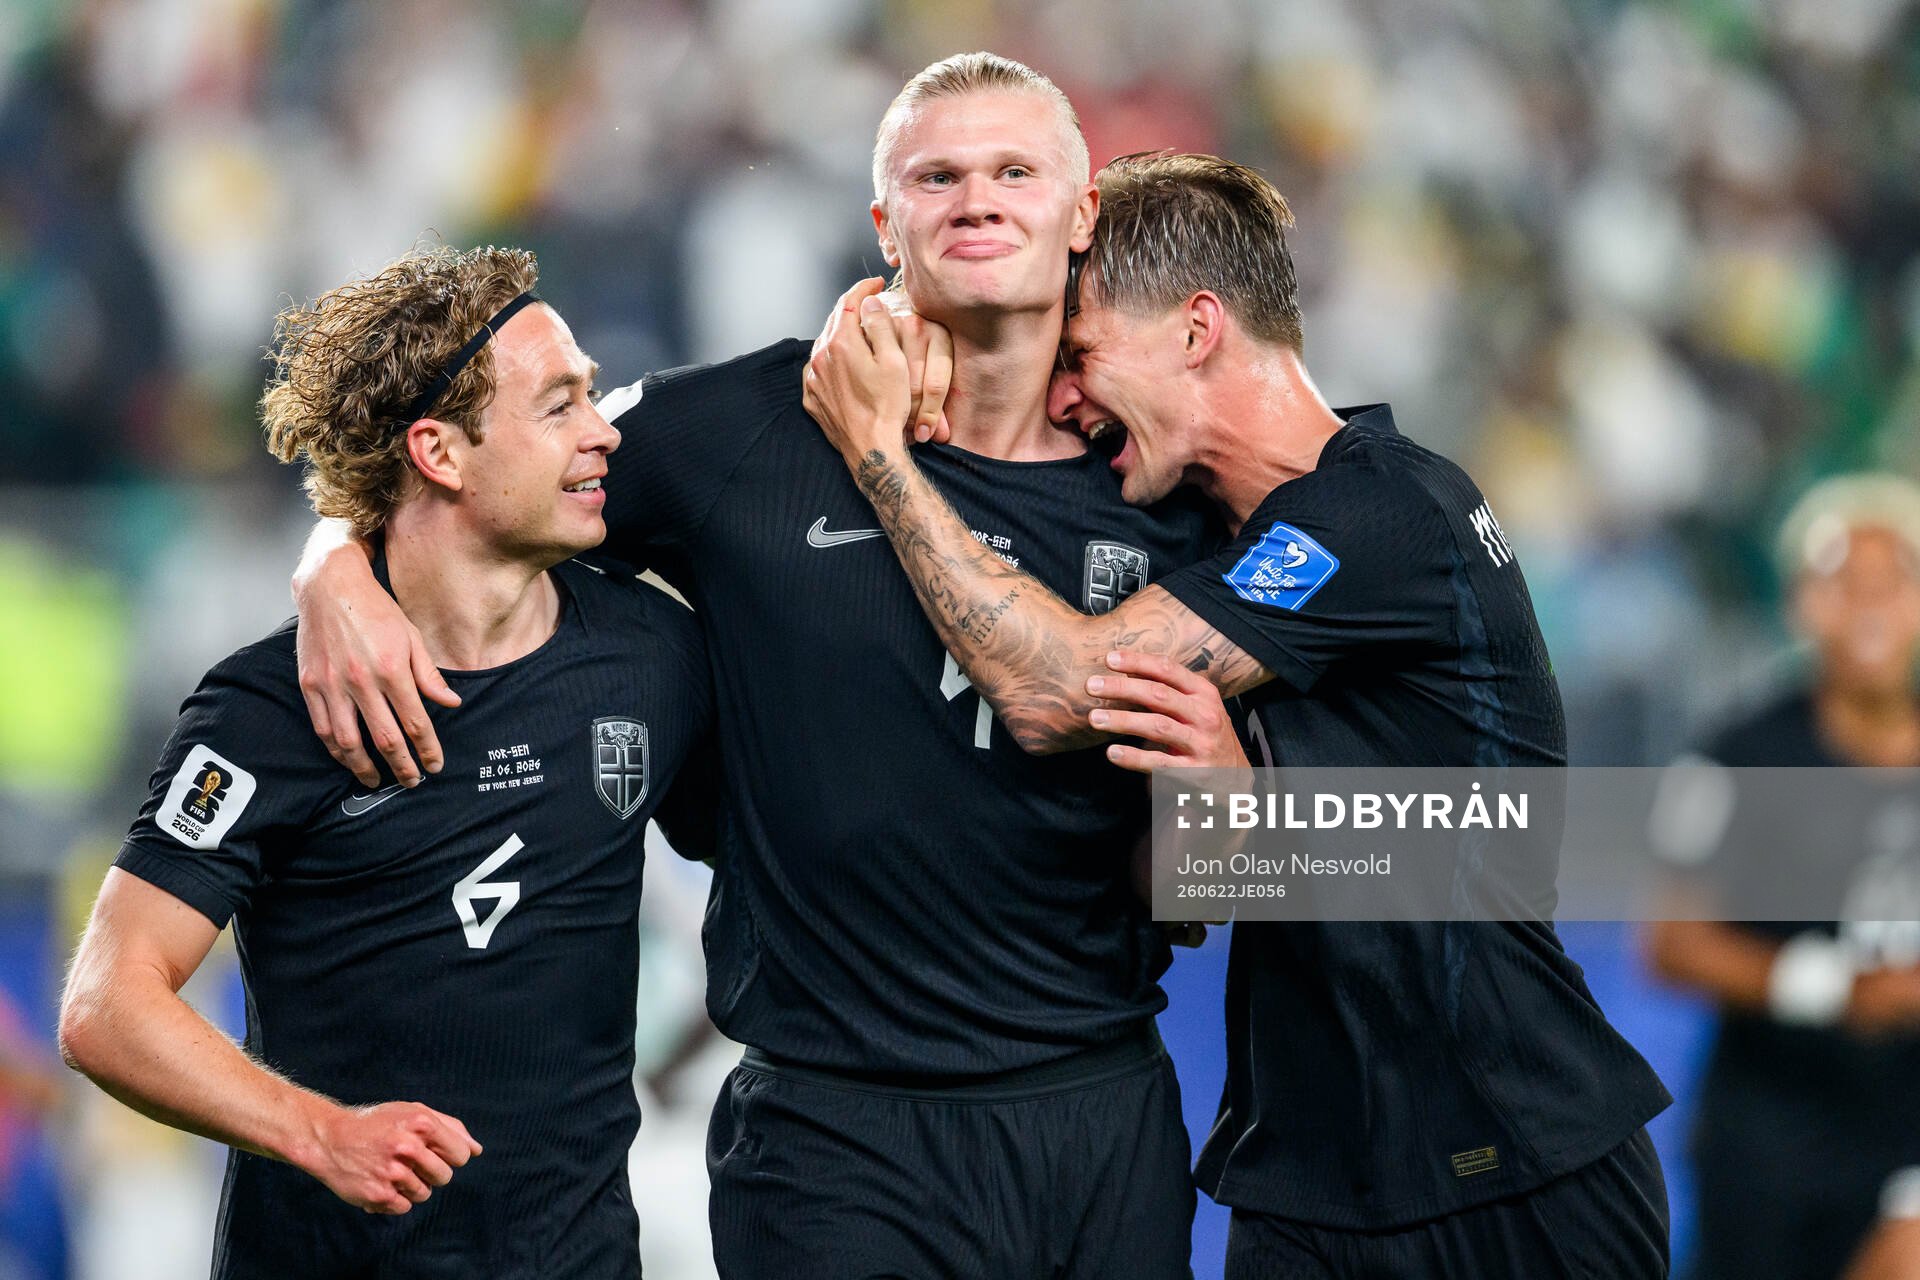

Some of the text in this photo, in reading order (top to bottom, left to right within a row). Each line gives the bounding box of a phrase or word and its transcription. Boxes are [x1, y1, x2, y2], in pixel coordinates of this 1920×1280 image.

[970, 529, 1011, 550] NOR-SEN
[1250, 569, 1285, 601] PEACE
[488, 744, 530, 760] NOR-SEN
[478, 774, 544, 792] NEW YORK NEW JERSEY
[176, 812, 206, 833] WORLD CUP
[190, 806, 206, 819] FIFA
[171, 819, 201, 842] 2026
[451, 832, 526, 949] 6
